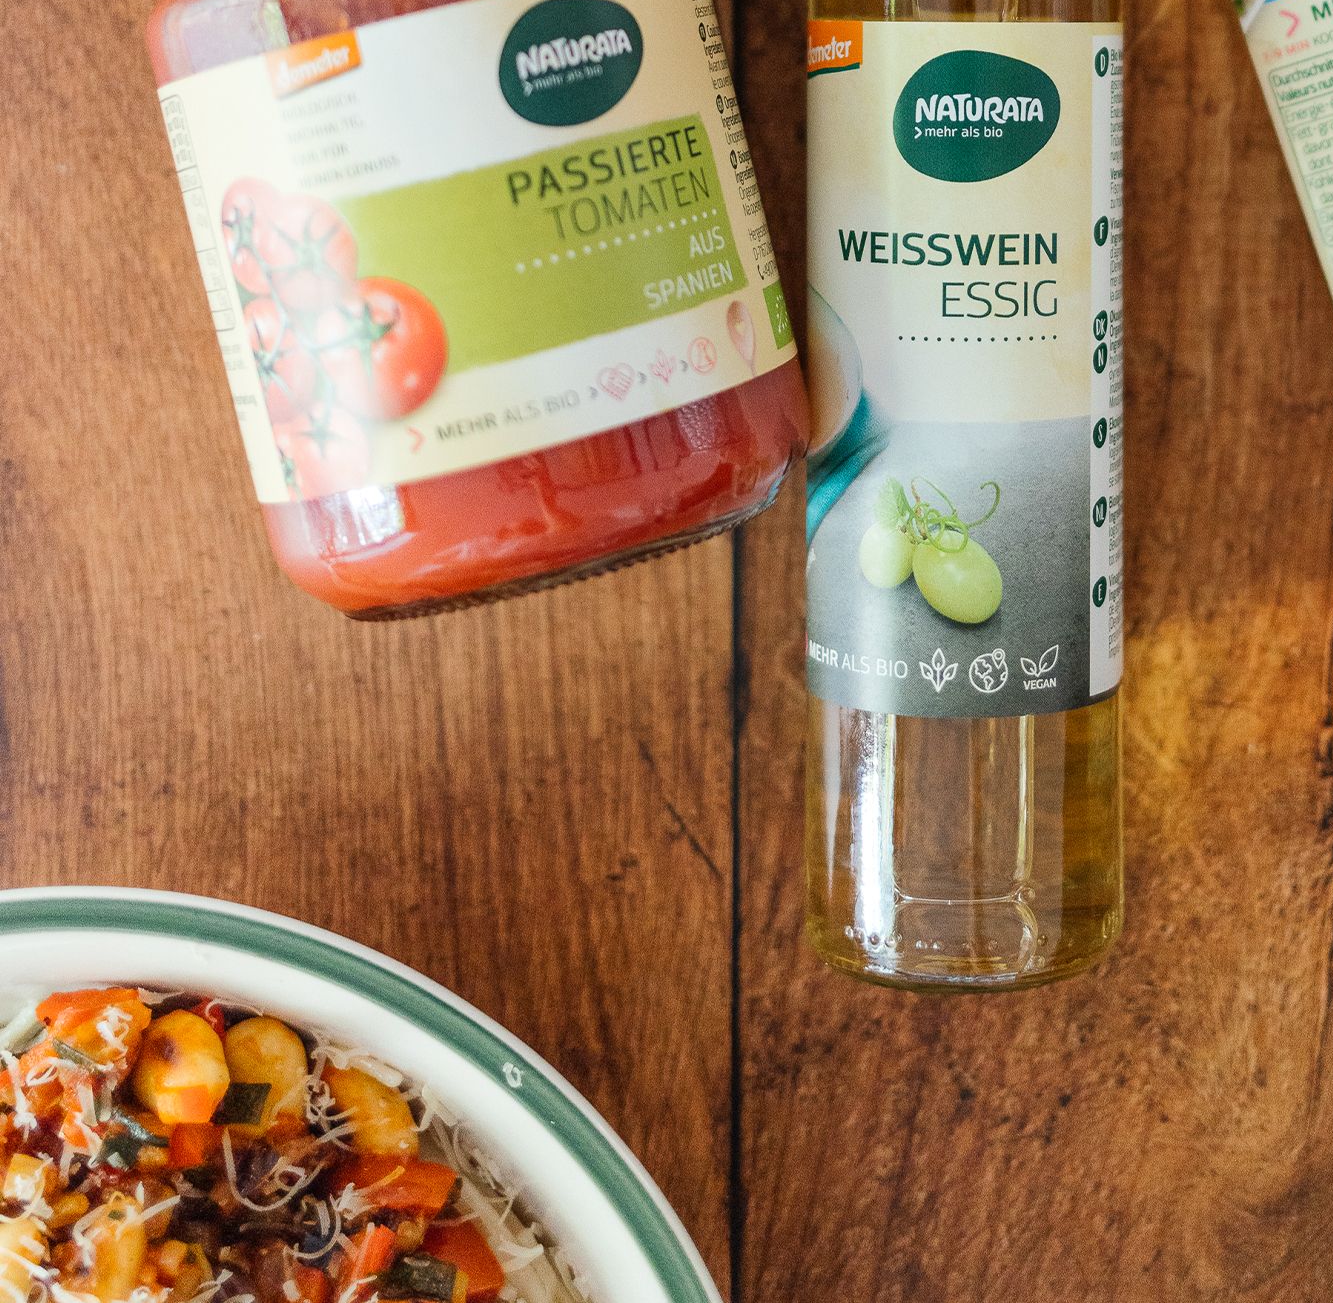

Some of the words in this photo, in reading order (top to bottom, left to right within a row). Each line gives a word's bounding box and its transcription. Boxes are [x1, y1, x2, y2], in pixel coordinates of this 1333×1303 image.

[512, 21, 634, 82] NATURATA
[915, 93, 1044, 124] NATURATA
[924, 126, 958, 138] mehr
[961, 125, 980, 138] als
[984, 125, 1004, 138] bio
[504, 125, 704, 207] PASSIERTE
[544, 166, 712, 242] TOMATEN
[688, 225, 727, 259] AUS
[838, 228, 1058, 267] WEISSWEIN
[642, 259, 736, 310] SPANIEN
[941, 279, 1058, 319] ESSIG
[433, 409, 499, 444] MEHR
[500, 398, 542, 426] ALS
[540, 386, 582, 415] BIO
[807, 638, 839, 669] MEHR
[841, 655, 871, 674] ALS
[876, 658, 909, 679] BIO
[1022, 677, 1058, 691] VEGAN
